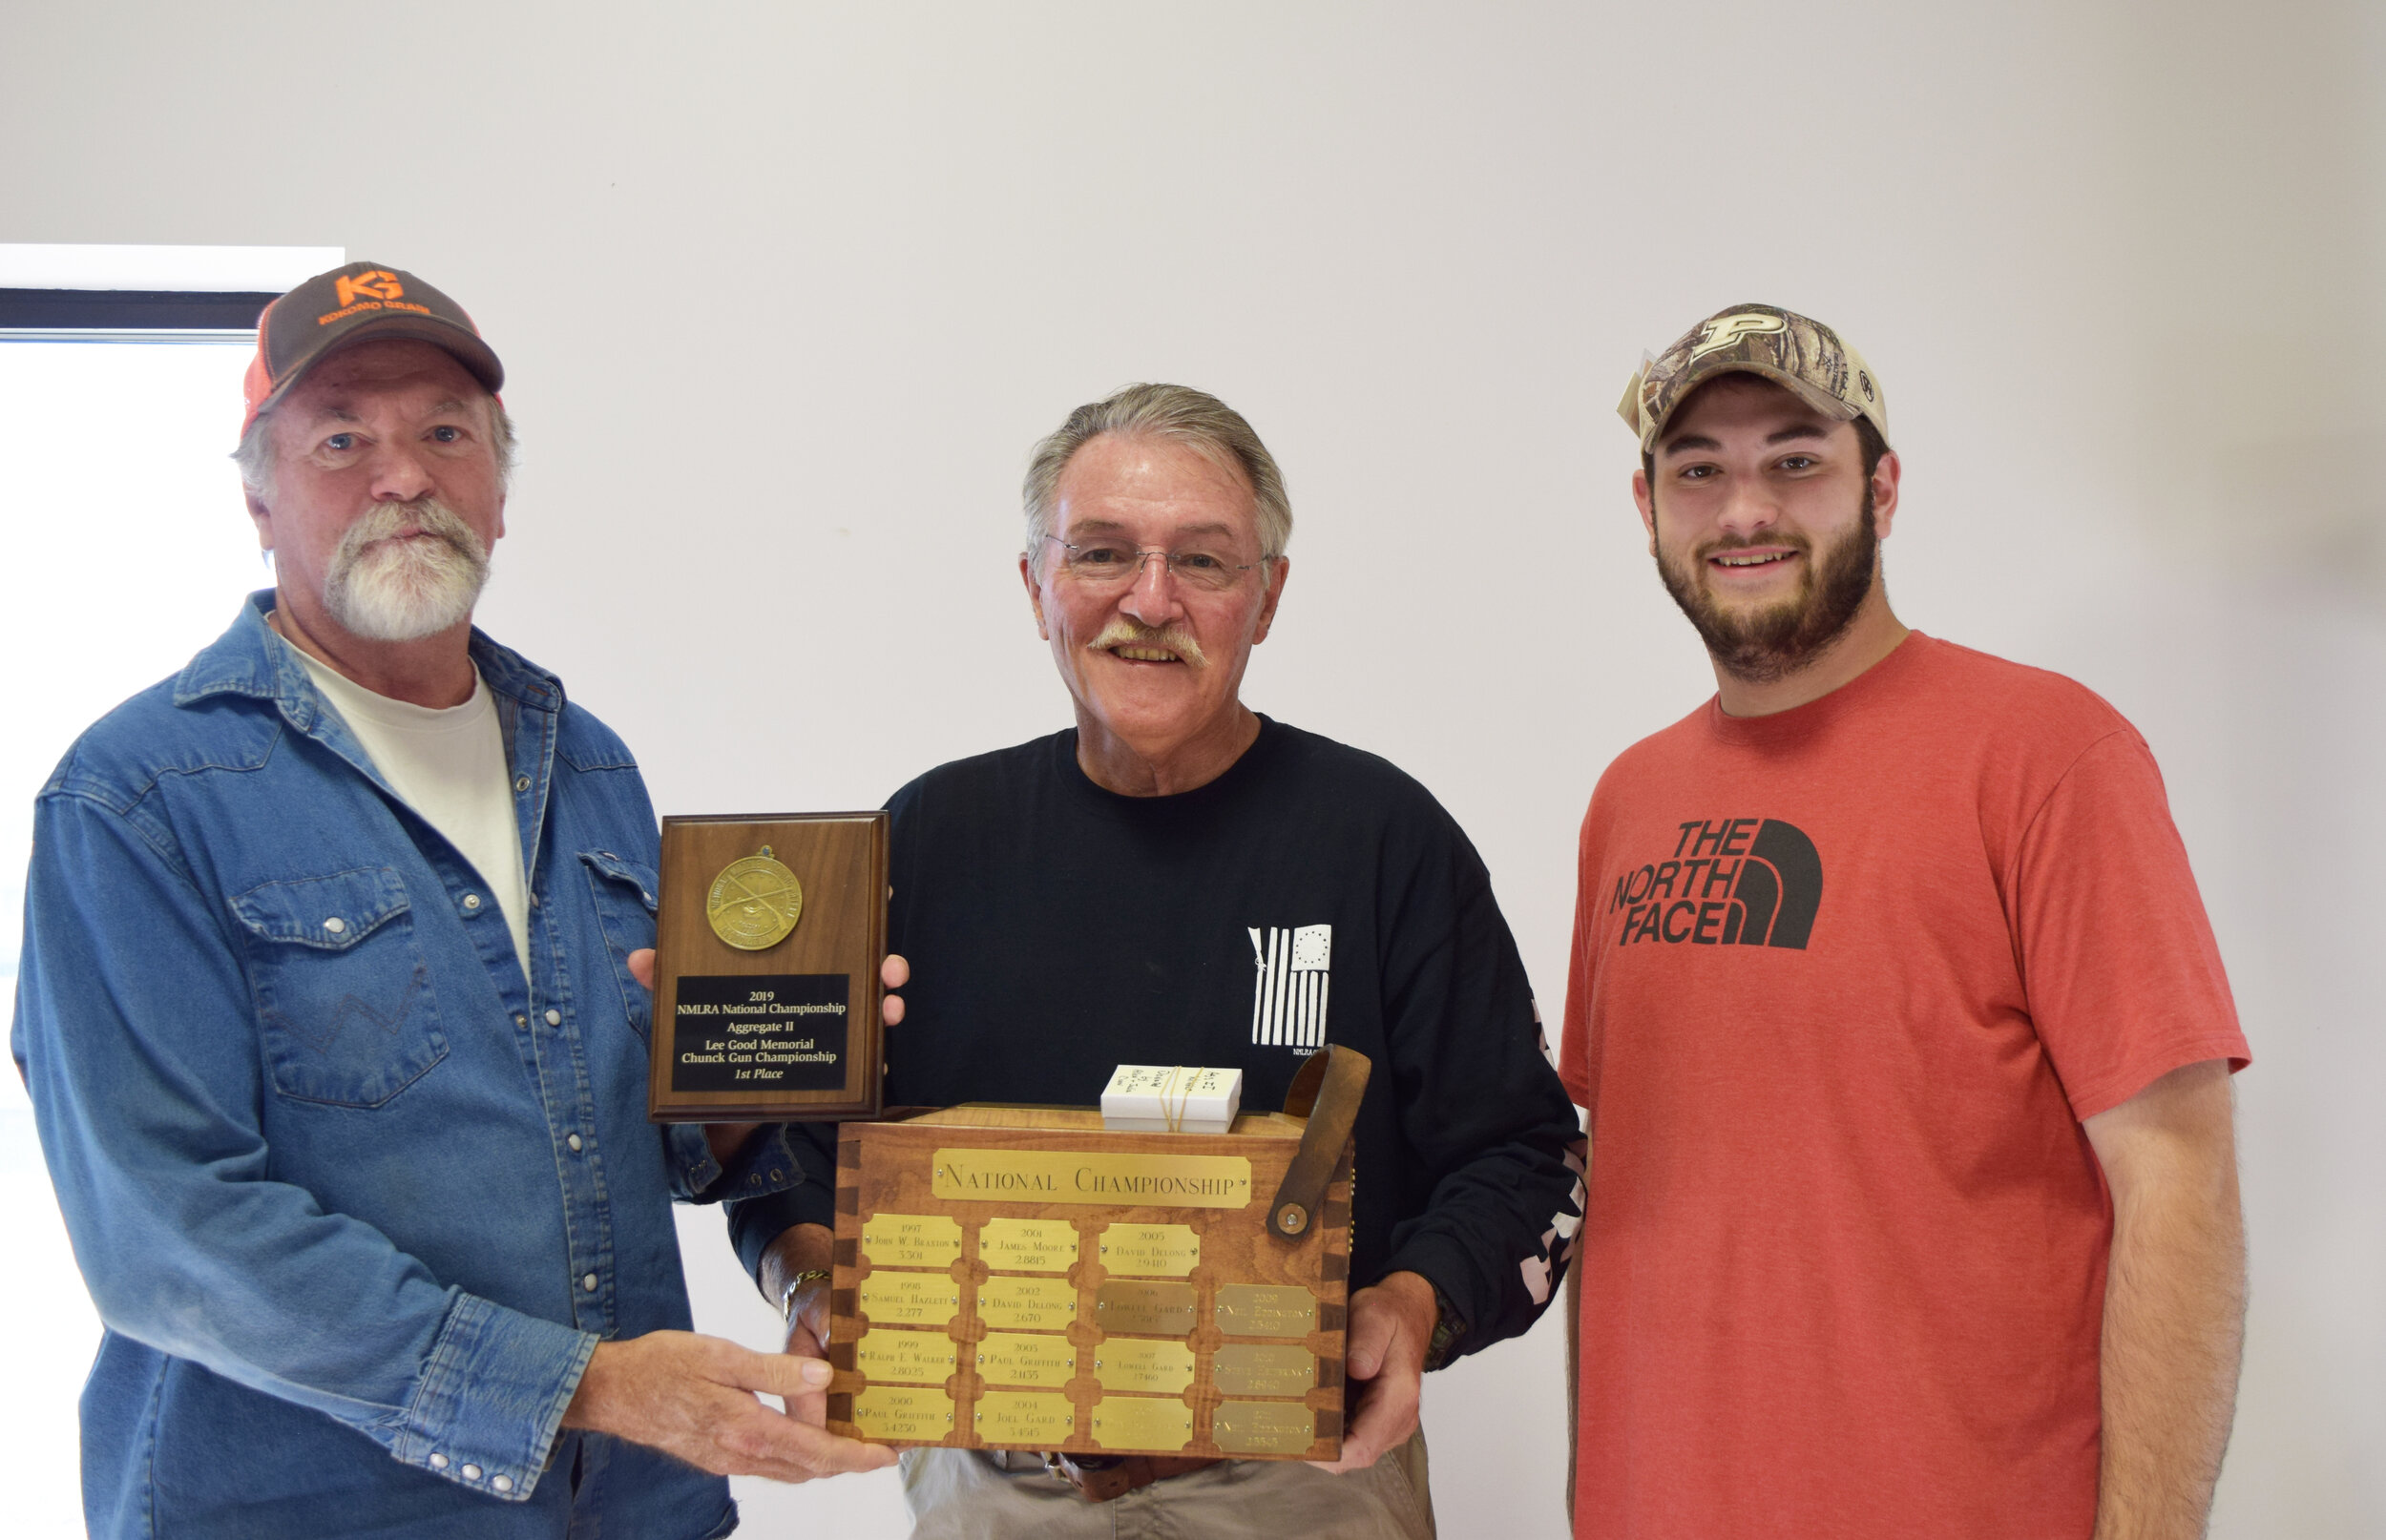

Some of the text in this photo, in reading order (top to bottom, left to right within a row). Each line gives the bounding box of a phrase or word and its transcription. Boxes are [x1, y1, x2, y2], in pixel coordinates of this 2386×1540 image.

[317, 300, 430, 325] KOKOMO GRAIN
[1688, 313, 1788, 365] P
[1673, 818, 1759, 858] THE
[1609, 858, 1741, 914] NORTH
[1619, 900, 1726, 947] FACE
[749, 990, 775, 1002] 2019
[677, 1002, 847, 1016] NMLRA National Championship
[726, 1021, 794, 1034] Aggregate II
[705, 1037, 814, 1051] Lee Good Memorial
[681, 1051, 837, 1065] Chunck Gun Championship
[735, 1068, 784, 1080] 1st Place
[944, 1162, 1235, 1197] NATIONAL CHAMPIONSHIP
[901, 1224, 923, 1233] 1997
[1021, 1228, 1042, 1238] 2001
[874, 1236, 893, 1245] JOHN
[1138, 1231, 1165, 1240] 2005
[999, 1239, 1064, 1252] JAMES MOORE
[1116, 1246, 1145, 1257] DAVID
[900, 1281, 922, 1290] 1998
[1016, 1286, 1041, 1296] 2002
[871, 1292, 904, 1303] SAMUEL
[992, 1298, 1062, 1310] DAVID DELONG
[1154, 1302, 1183, 1314] GARD
[898, 1340, 919, 1349] 1999
[869, 1351, 895, 1362] RALPH
[913, 1352, 945, 1363] WALKER
[990, 1354, 1060, 1367] PAUL GRIFFITH
[1152, 1363, 1174, 1372] GARD
[888, 1396, 913, 1405] 2000
[1015, 1401, 1037, 1409] 2004
[865, 1407, 935, 1421] PAUL GRIFFITH
[996, 1412, 1056, 1424] JOEL GARD
